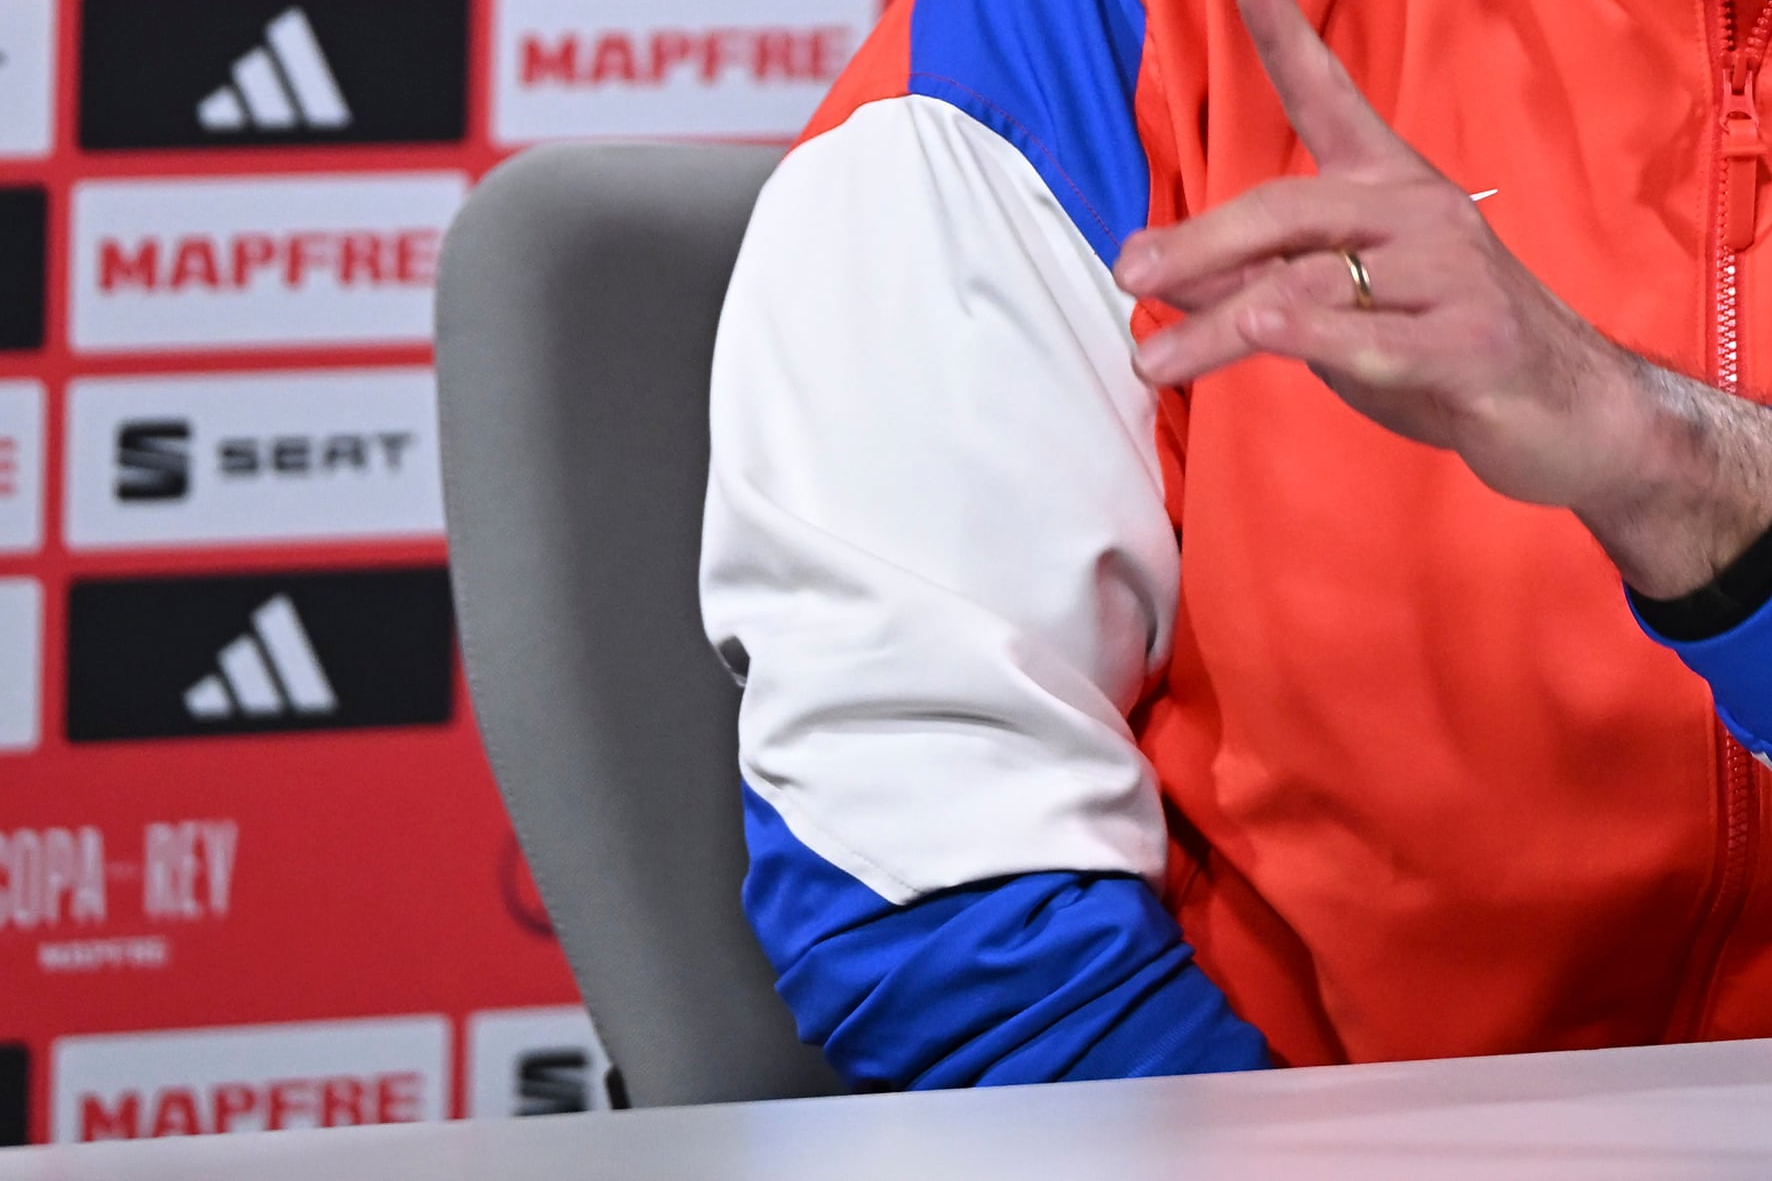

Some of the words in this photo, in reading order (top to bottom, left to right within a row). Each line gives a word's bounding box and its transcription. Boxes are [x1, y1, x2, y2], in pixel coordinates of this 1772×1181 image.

[519, 27, 850, 88] MAPFRE
[97, 231, 438, 294] MAPFRE
[217, 433, 416, 478] SEAT
[144, 821, 237, 918] REY
[79, 1073, 421, 1143] MAPFRE
